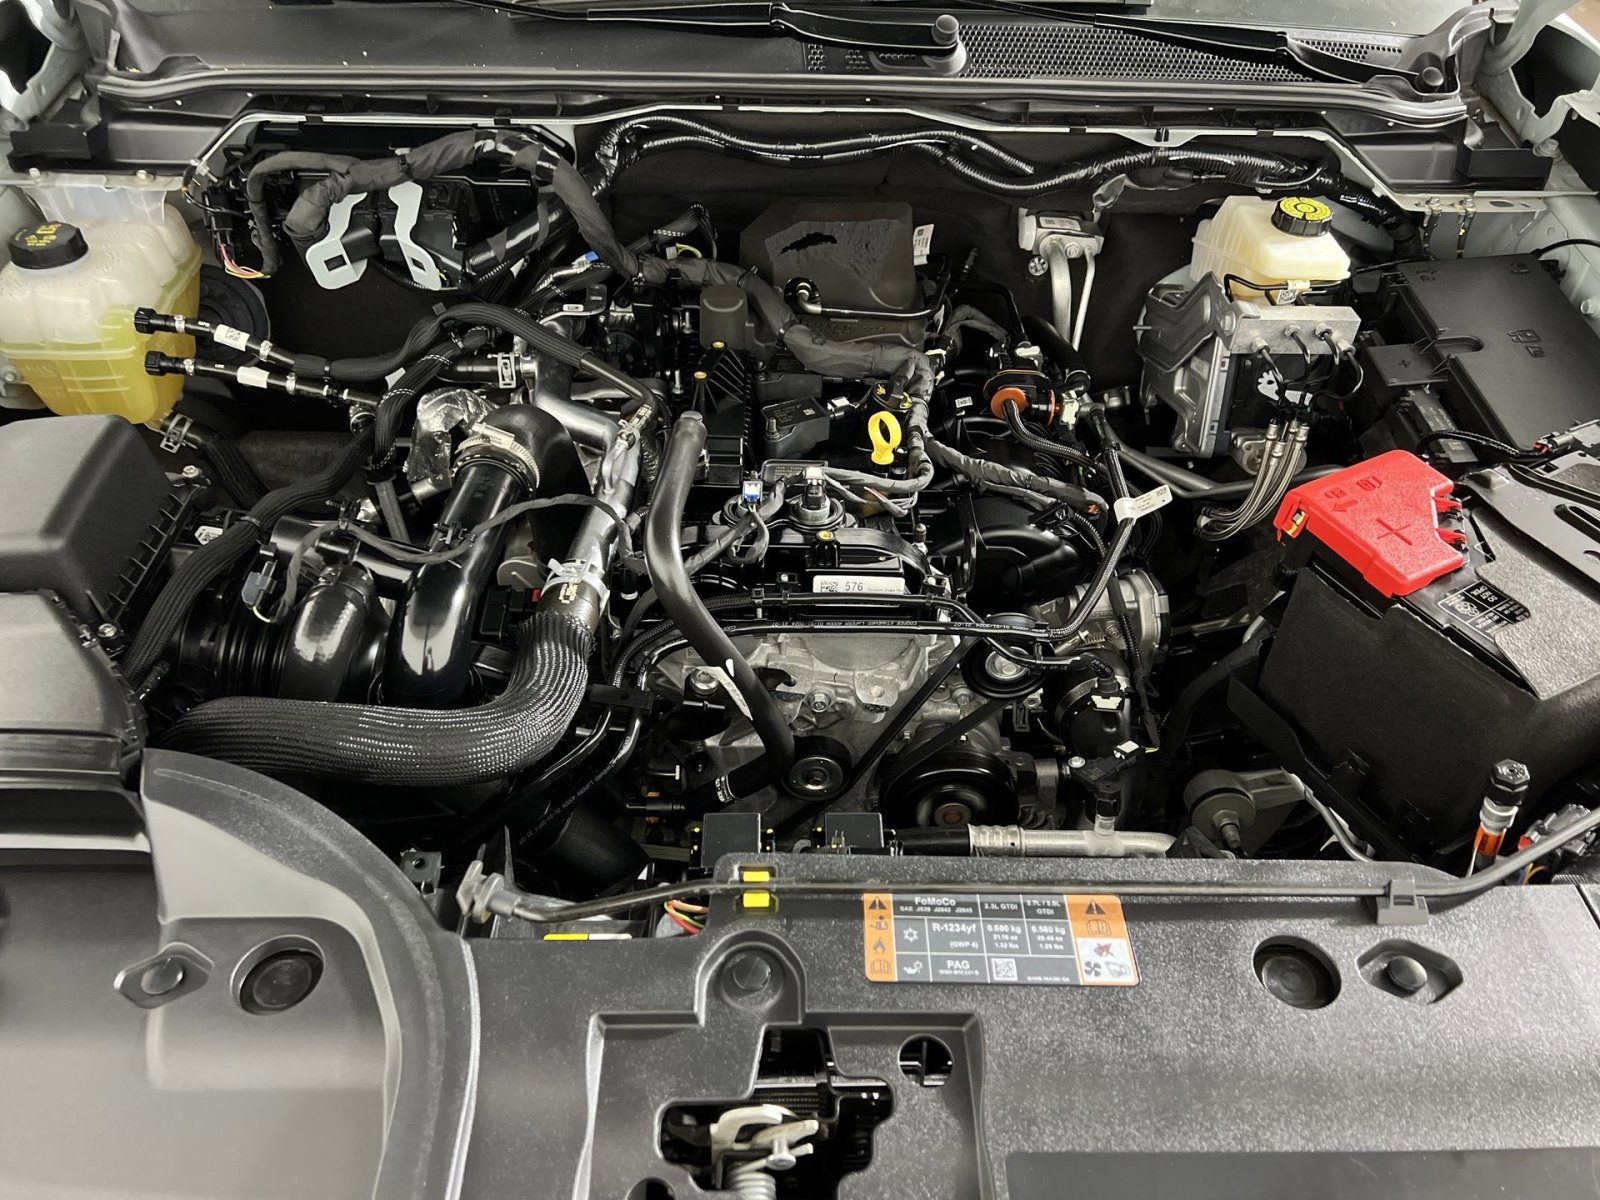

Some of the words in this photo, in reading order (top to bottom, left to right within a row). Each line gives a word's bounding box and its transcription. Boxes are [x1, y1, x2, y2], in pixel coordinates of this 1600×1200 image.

[845, 582, 864, 592] 576
[914, 896, 956, 906] FoMoCo
[932, 922, 976, 935] R-1234yf
[1010, 925, 1021, 934] kg
[1055, 926, 1066, 935] kg
[947, 960, 970, 969] PAG
